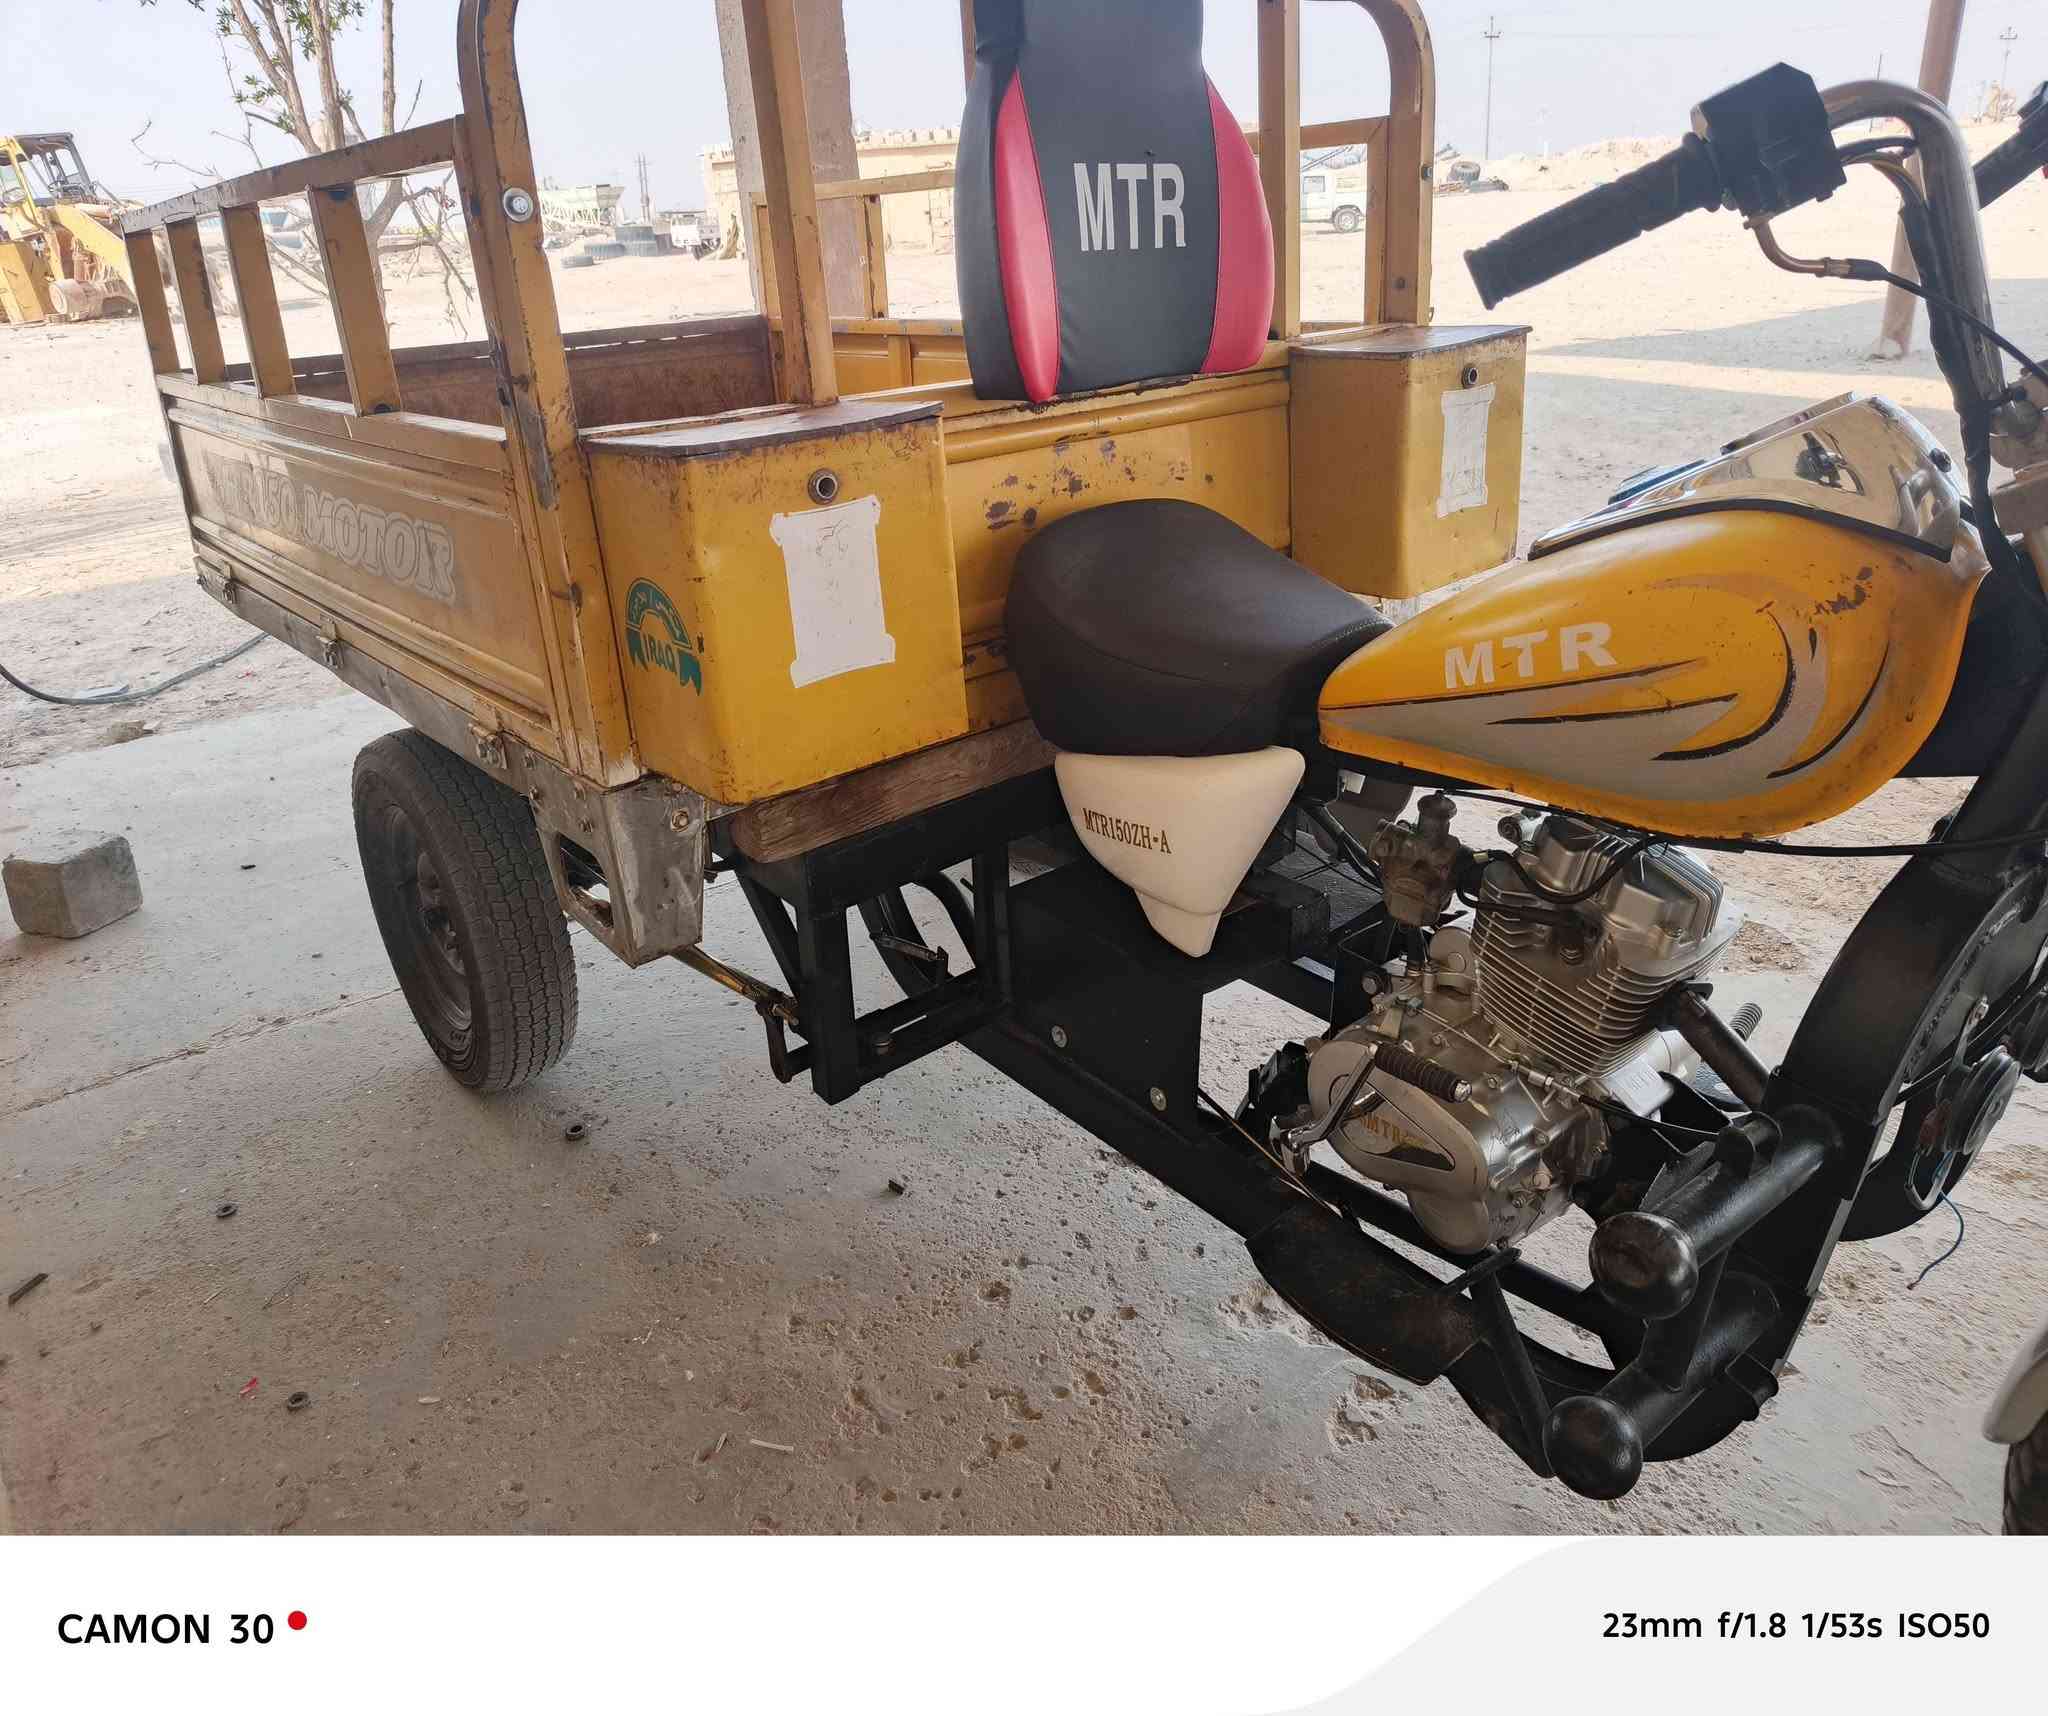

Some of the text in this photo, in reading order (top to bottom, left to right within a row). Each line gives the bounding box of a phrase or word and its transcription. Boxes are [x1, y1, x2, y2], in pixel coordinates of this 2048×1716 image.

[1073, 162, 1187, 251] MTR
[301, 484, 456, 604] MOTOR
[643, 632, 678, 677] IRAQ
[1444, 622, 1617, 689] MTR
[1082, 807, 1172, 854] MTR150ZH-A
